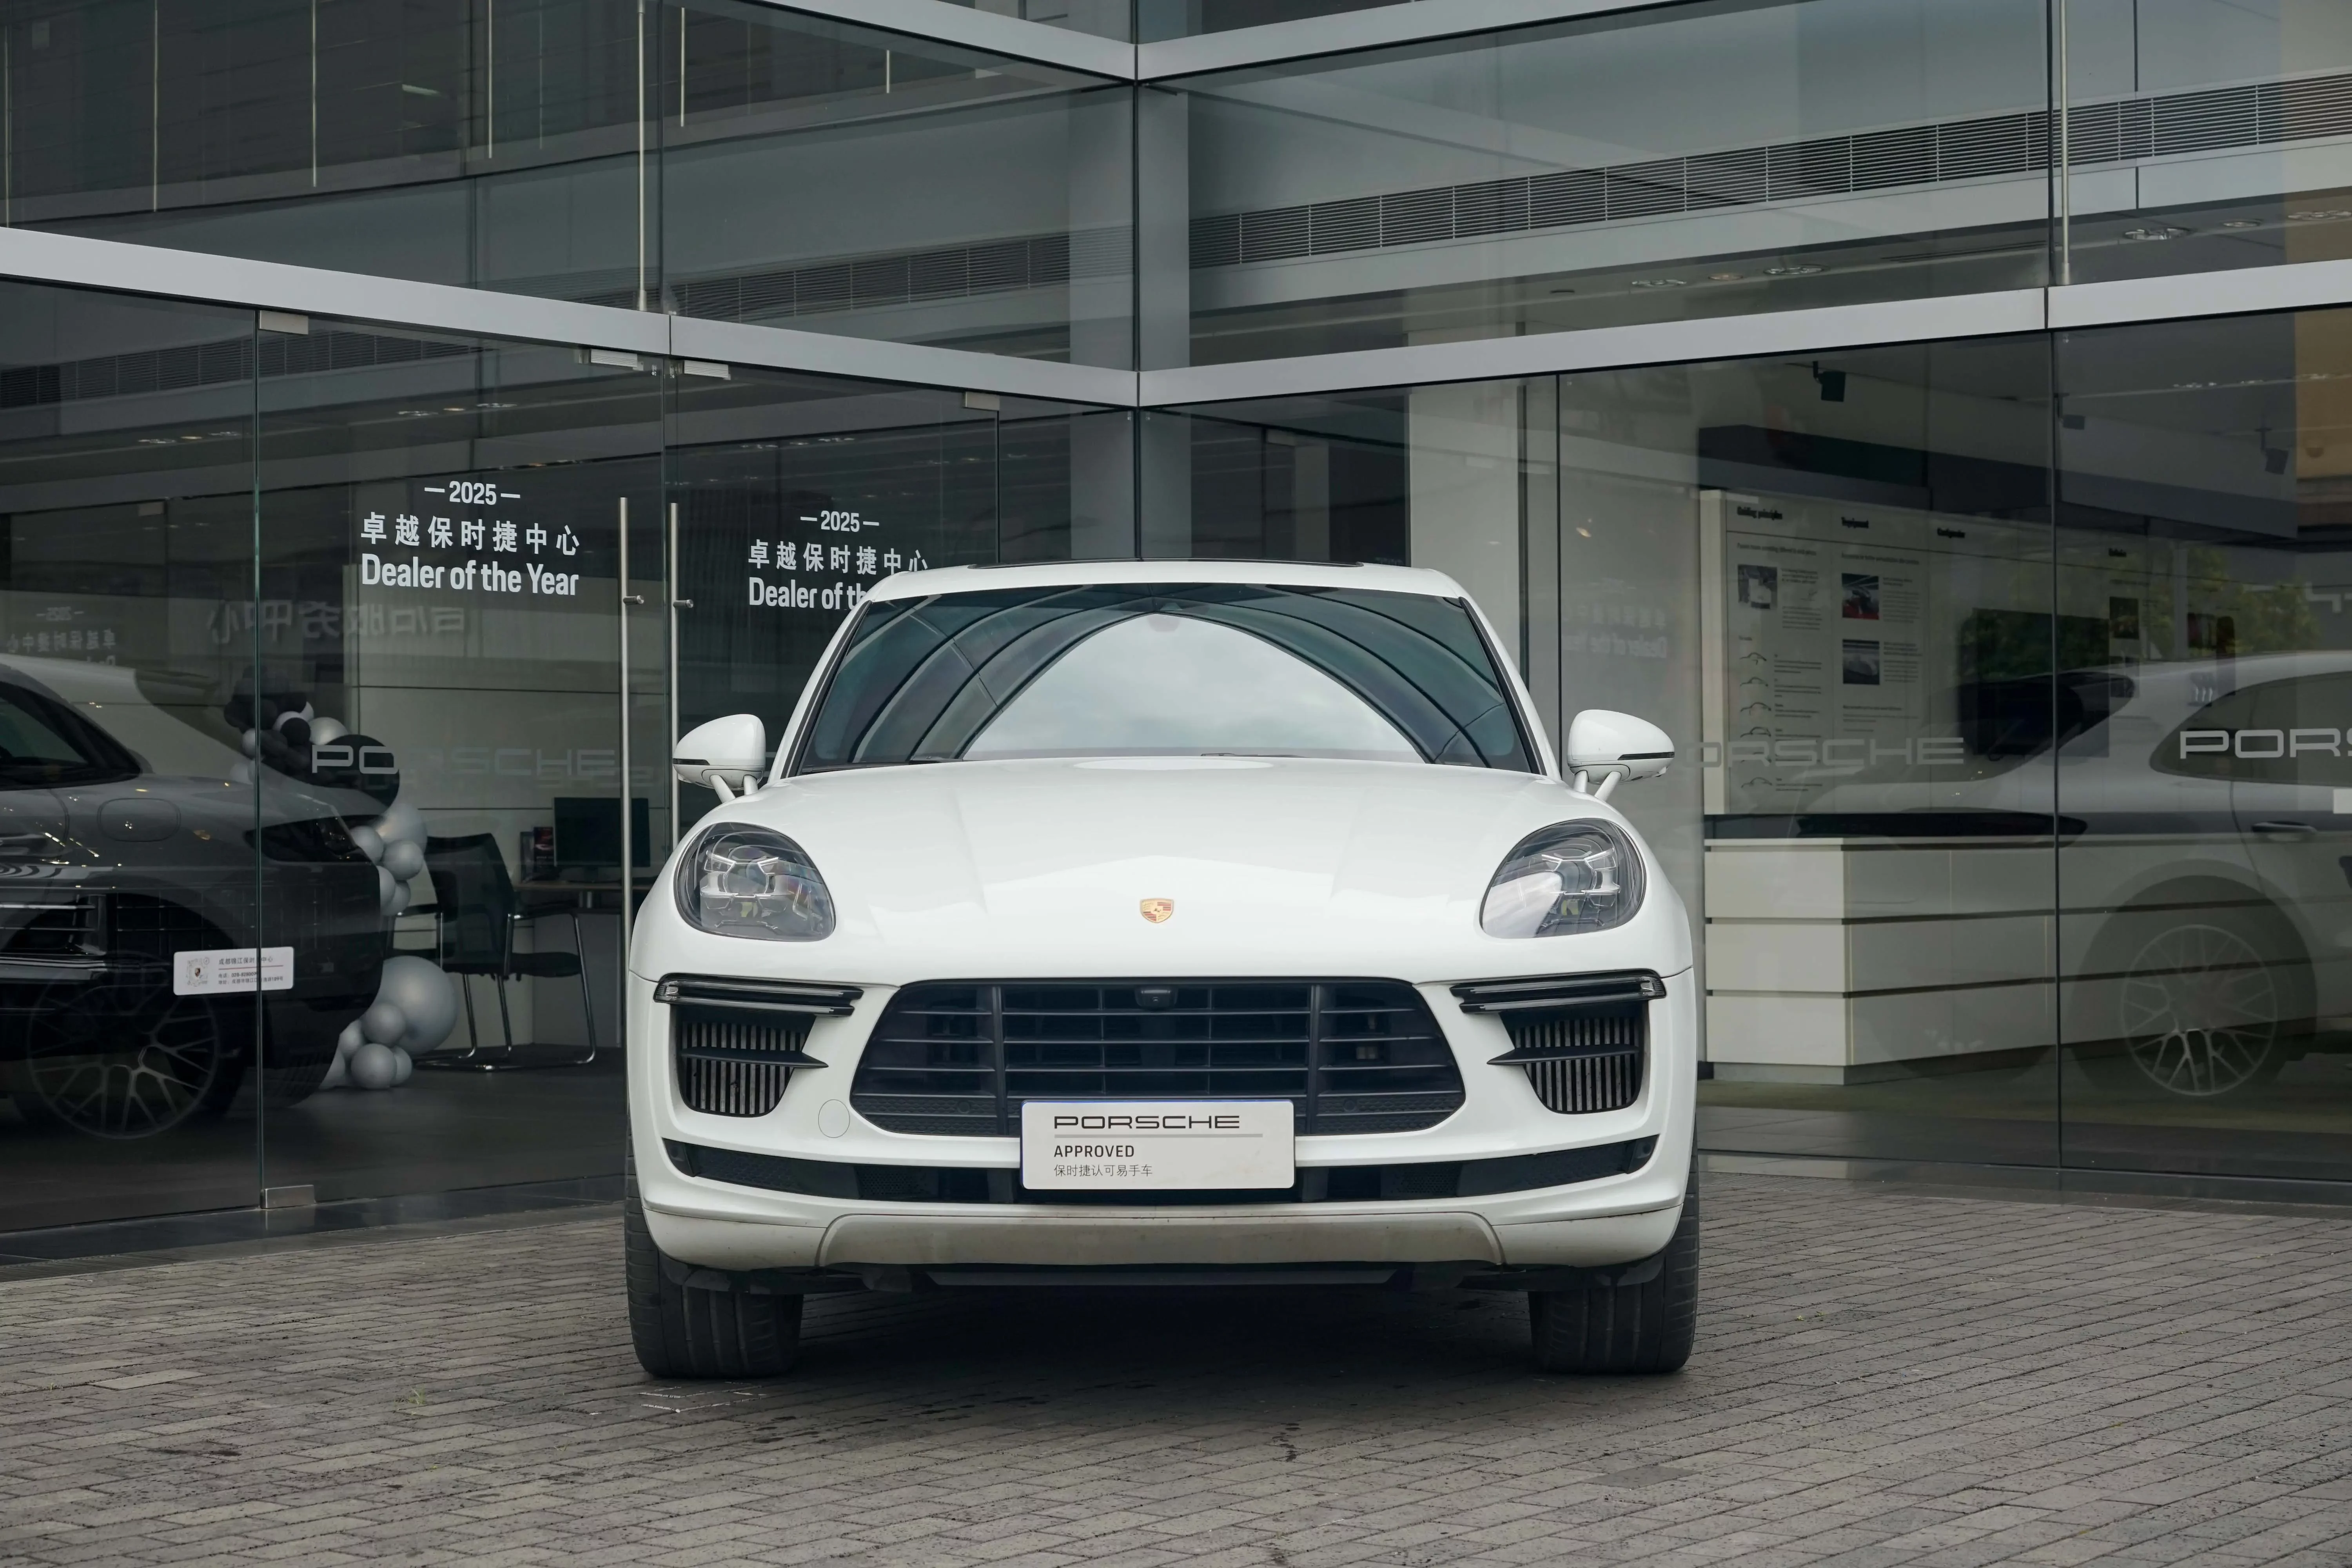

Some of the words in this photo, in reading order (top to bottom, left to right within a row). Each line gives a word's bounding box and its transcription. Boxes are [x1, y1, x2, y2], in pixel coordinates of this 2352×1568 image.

[361, 512, 579, 555] 卓越保时捷中心
[748, 539, 928, 575] 卓越保时捷中心
[362, 553, 445, 588] Dealer
[450, 560, 476, 590] of
[481, 561, 521, 593] the
[526, 563, 579, 595] Year
[749, 577, 817, 608] Dealer
[822, 582, 843, 610] of
[847, 583, 867, 610] th
[1682, 737, 1964, 768] ORSCHE
[2180, 728, 2352, 760] POR
[1054, 1116, 1240, 1129] PORSCHE
[1054, 1145, 1134, 1157] APPROVED
[1054, 1164, 1152, 1176] 保时捷认可易手车
